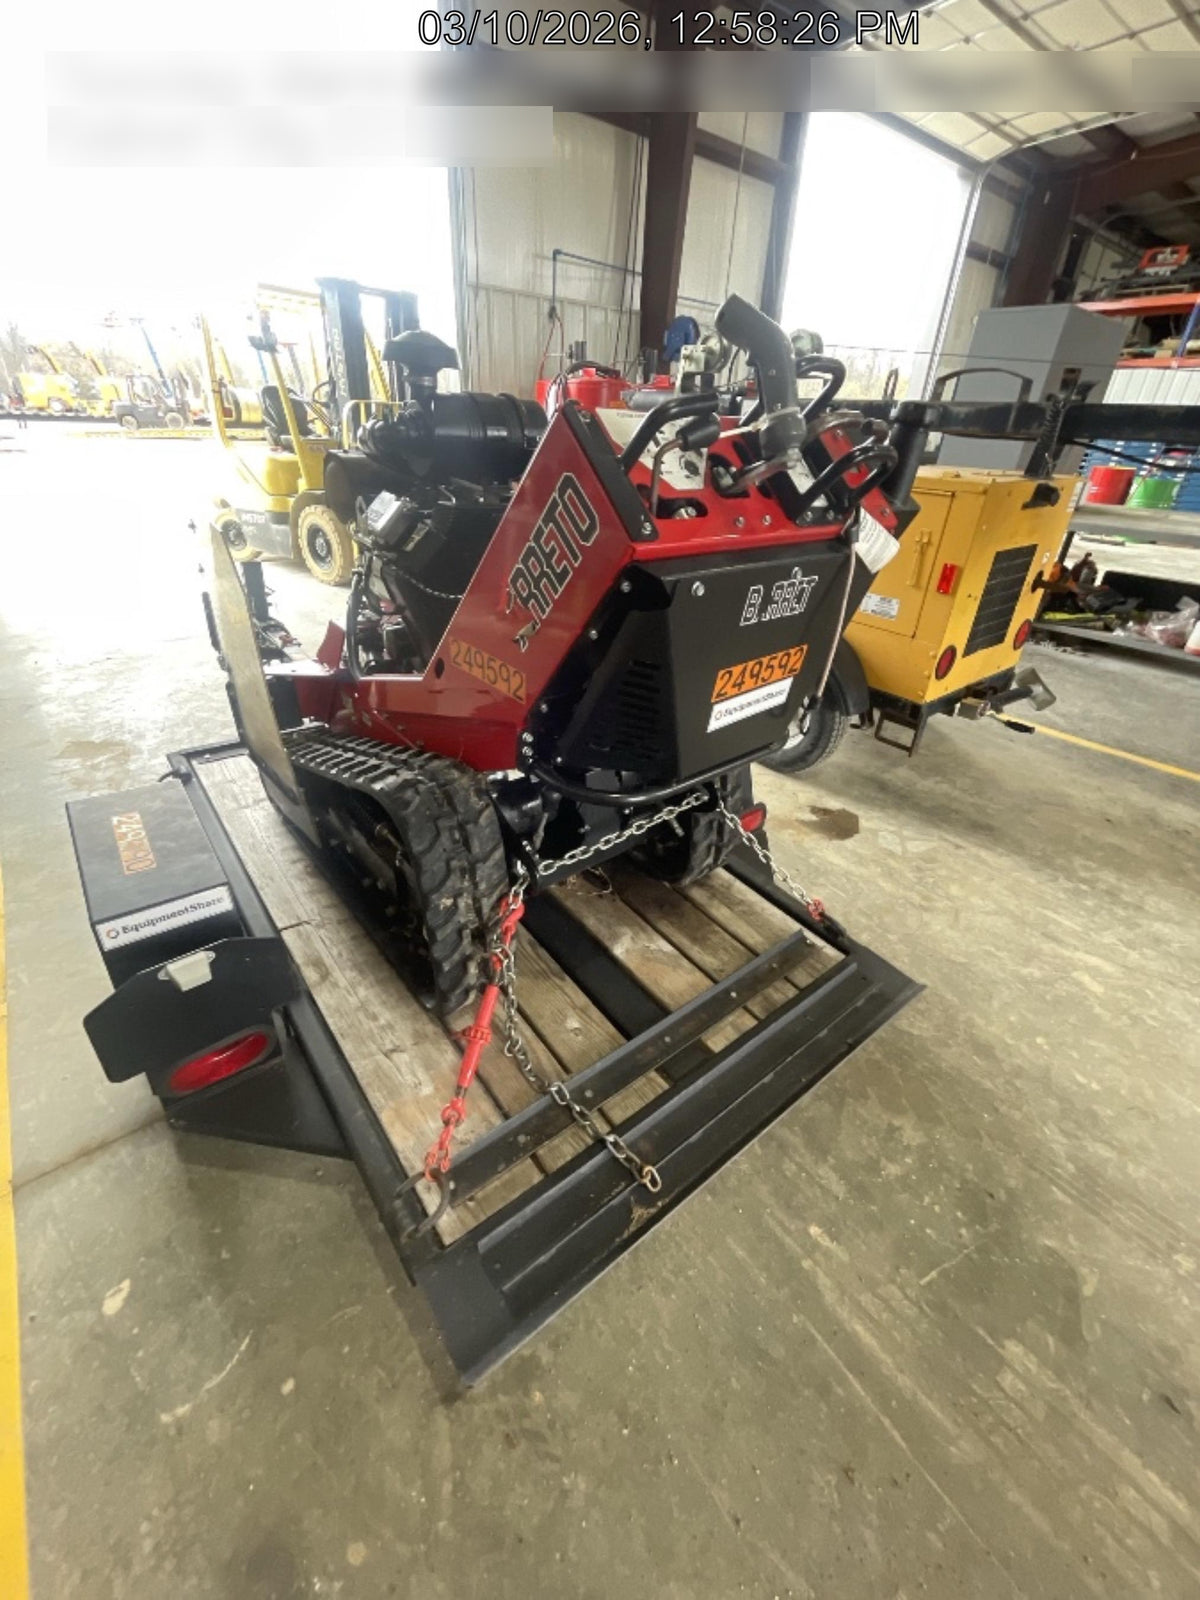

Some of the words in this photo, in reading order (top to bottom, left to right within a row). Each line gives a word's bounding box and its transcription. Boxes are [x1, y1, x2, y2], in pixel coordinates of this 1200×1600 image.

[453, 639, 525, 701] 249592
[713, 646, 805, 700] 249592
[121, 896, 225, 935] EquipmentShare
